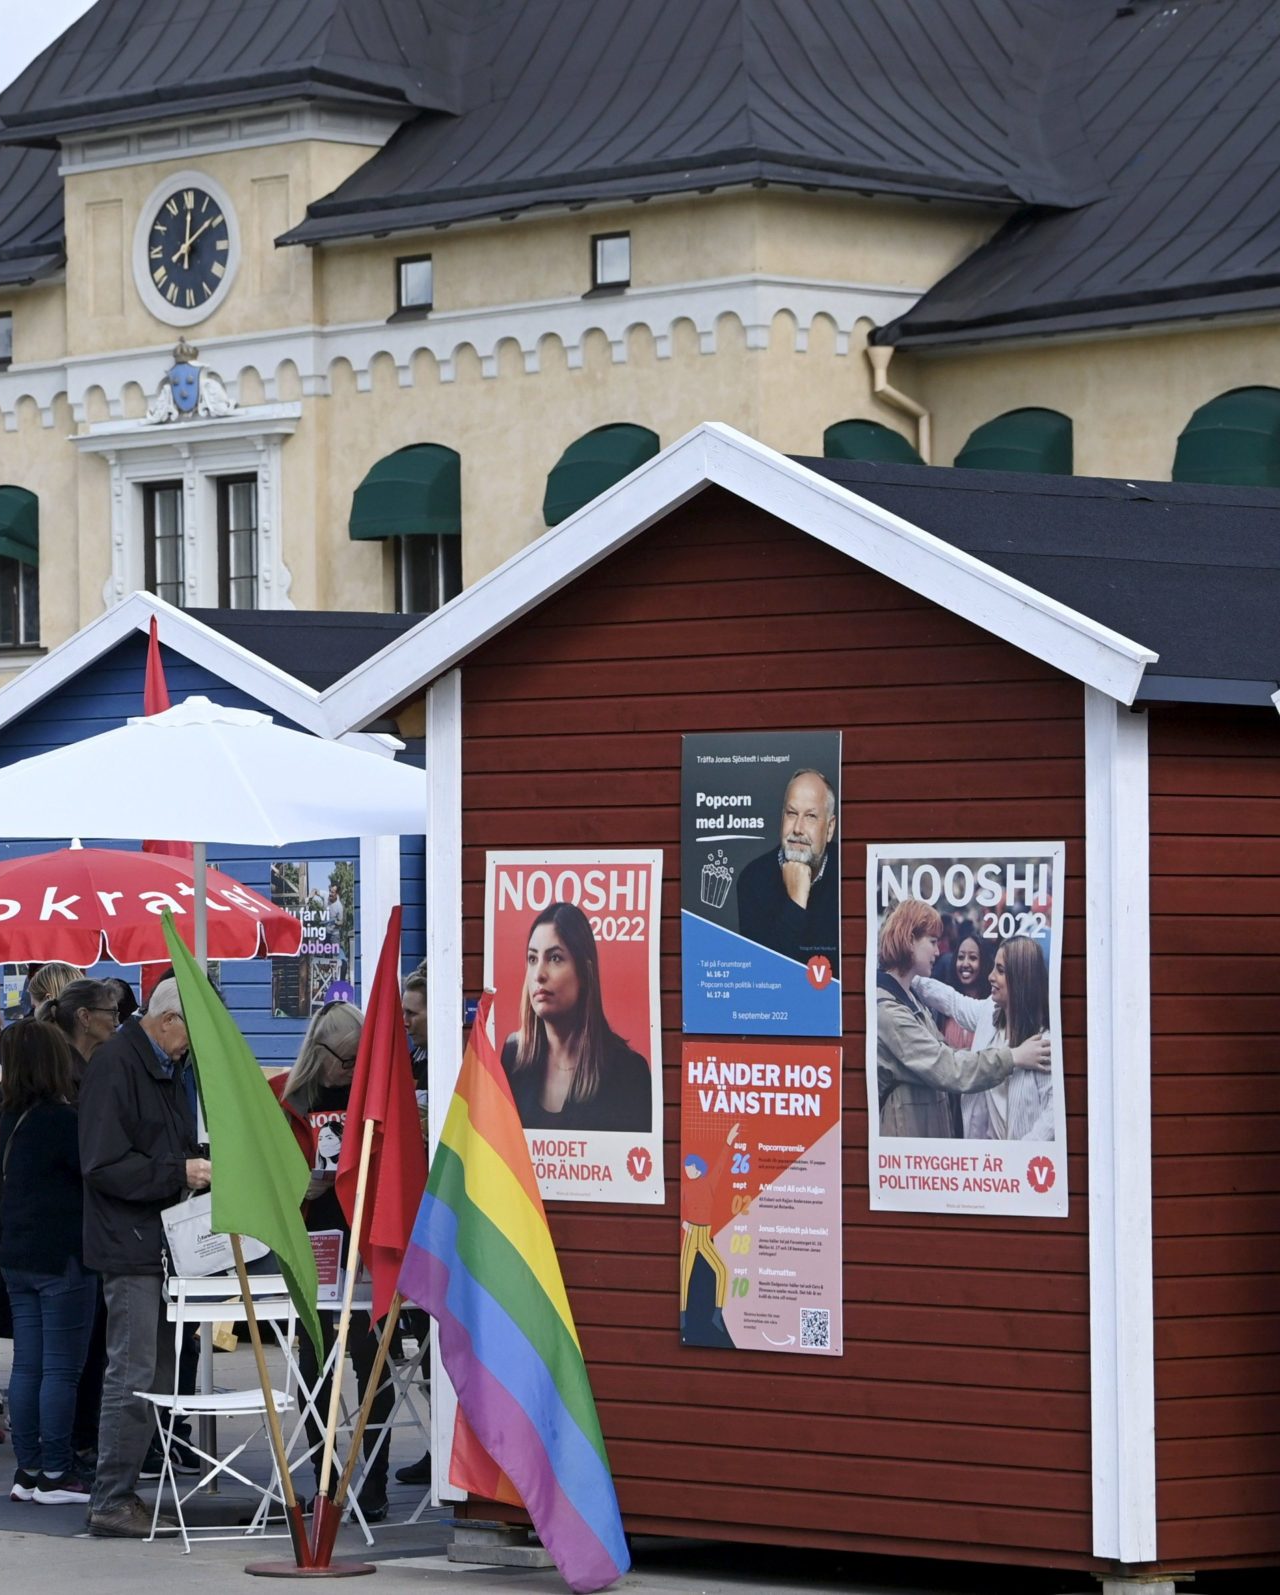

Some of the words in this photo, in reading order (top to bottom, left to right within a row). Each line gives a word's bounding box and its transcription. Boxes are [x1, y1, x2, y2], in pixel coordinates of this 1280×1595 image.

[732, 755, 756, 764] Sjöstedt
[760, 754, 790, 764] valstugan!
[696, 792, 752, 809] Popcorn
[696, 814, 724, 829] med
[727, 814, 764, 829] Jonas
[499, 870, 646, 911] NOOSHI
[881, 864, 1048, 907] NOOSHI
[300, 906, 316, 921] får
[320, 907, 330, 921] vi
[590, 916, 645, 941] 2022
[983, 912, 1047, 938] 2022
[300, 940, 340, 954] obben
[717, 960, 752, 969] Forumtorget
[813, 965, 826, 982] V
[738, 1012, 770, 1020] september
[771, 1012, 788, 1020] 2022
[688, 1056, 780, 1086] HÄNDER
[785, 1065, 832, 1088] HOS
[698, 1085, 820, 1116] VÄNSTERN
[532, 1140, 587, 1157] MODET
[734, 1143, 747, 1151] aug
[758, 1143, 805, 1152] Popcornpremiär
[532, 1158, 612, 1181] ÖRÄNDRA
[632, 1156, 645, 1174] V
[731, 1153, 750, 1174] 26
[878, 1154, 901, 1169] DIN
[904, 1155, 978, 1172] TRYGGHET
[983, 1154, 1003, 1172] ÄR
[879, 1175, 959, 1191] POLITIKENS
[962, 1178, 1020, 1193] ANSVAR
[1033, 1166, 1049, 1184] V
[732, 1195, 752, 1216] 02
[759, 1224, 775, 1233] Jonas
[776, 1225, 800, 1235] Sjöstedt
[800, 1227, 808, 1236] på
[730, 1233, 751, 1254] 08
[759, 1268, 796, 1277] Kulturnatten
[732, 1277, 750, 1297] 10
